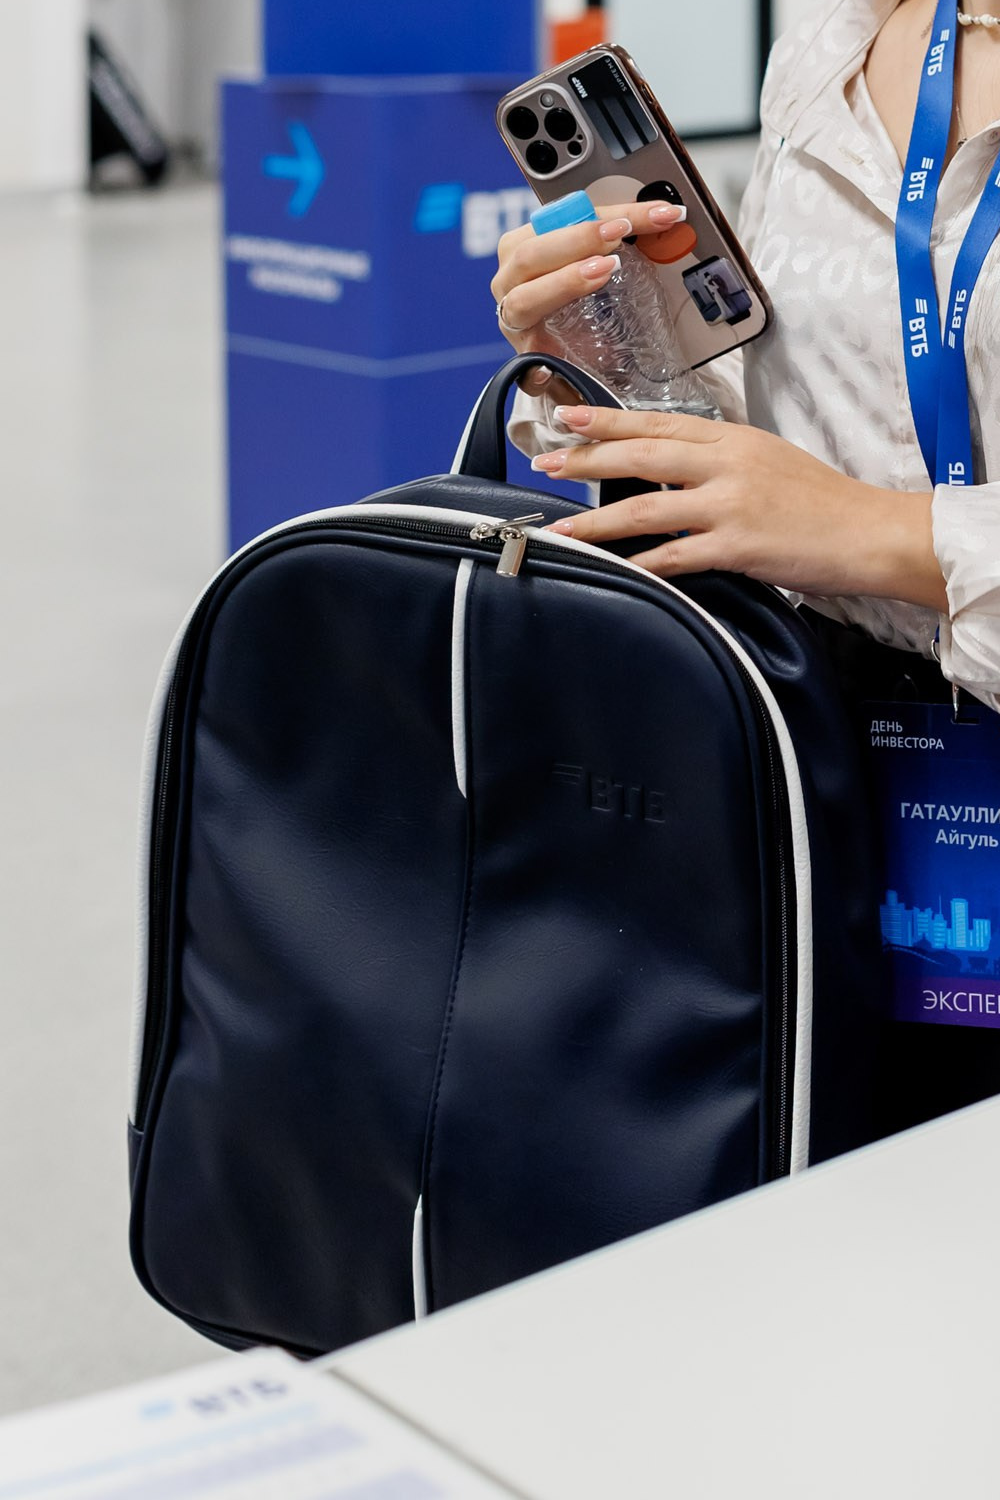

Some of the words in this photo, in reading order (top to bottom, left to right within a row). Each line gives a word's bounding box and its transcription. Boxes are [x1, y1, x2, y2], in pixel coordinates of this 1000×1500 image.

[604, 58, 627, 92] SUPREME
[927, 43, 945, 76] ВТБ
[906, 171, 927, 202] ВТБ
[462, 187, 541, 258] ВТ
[952, 289, 967, 329] ВТБ
[908, 317, 929, 357] ВТБ
[948, 461, 965, 486] ТБ
[870, 719, 903, 734] ДЕНЬ
[871, 735, 945, 751] ИНВЕСТОРА
[935, 828, 999, 850] Айгуль
